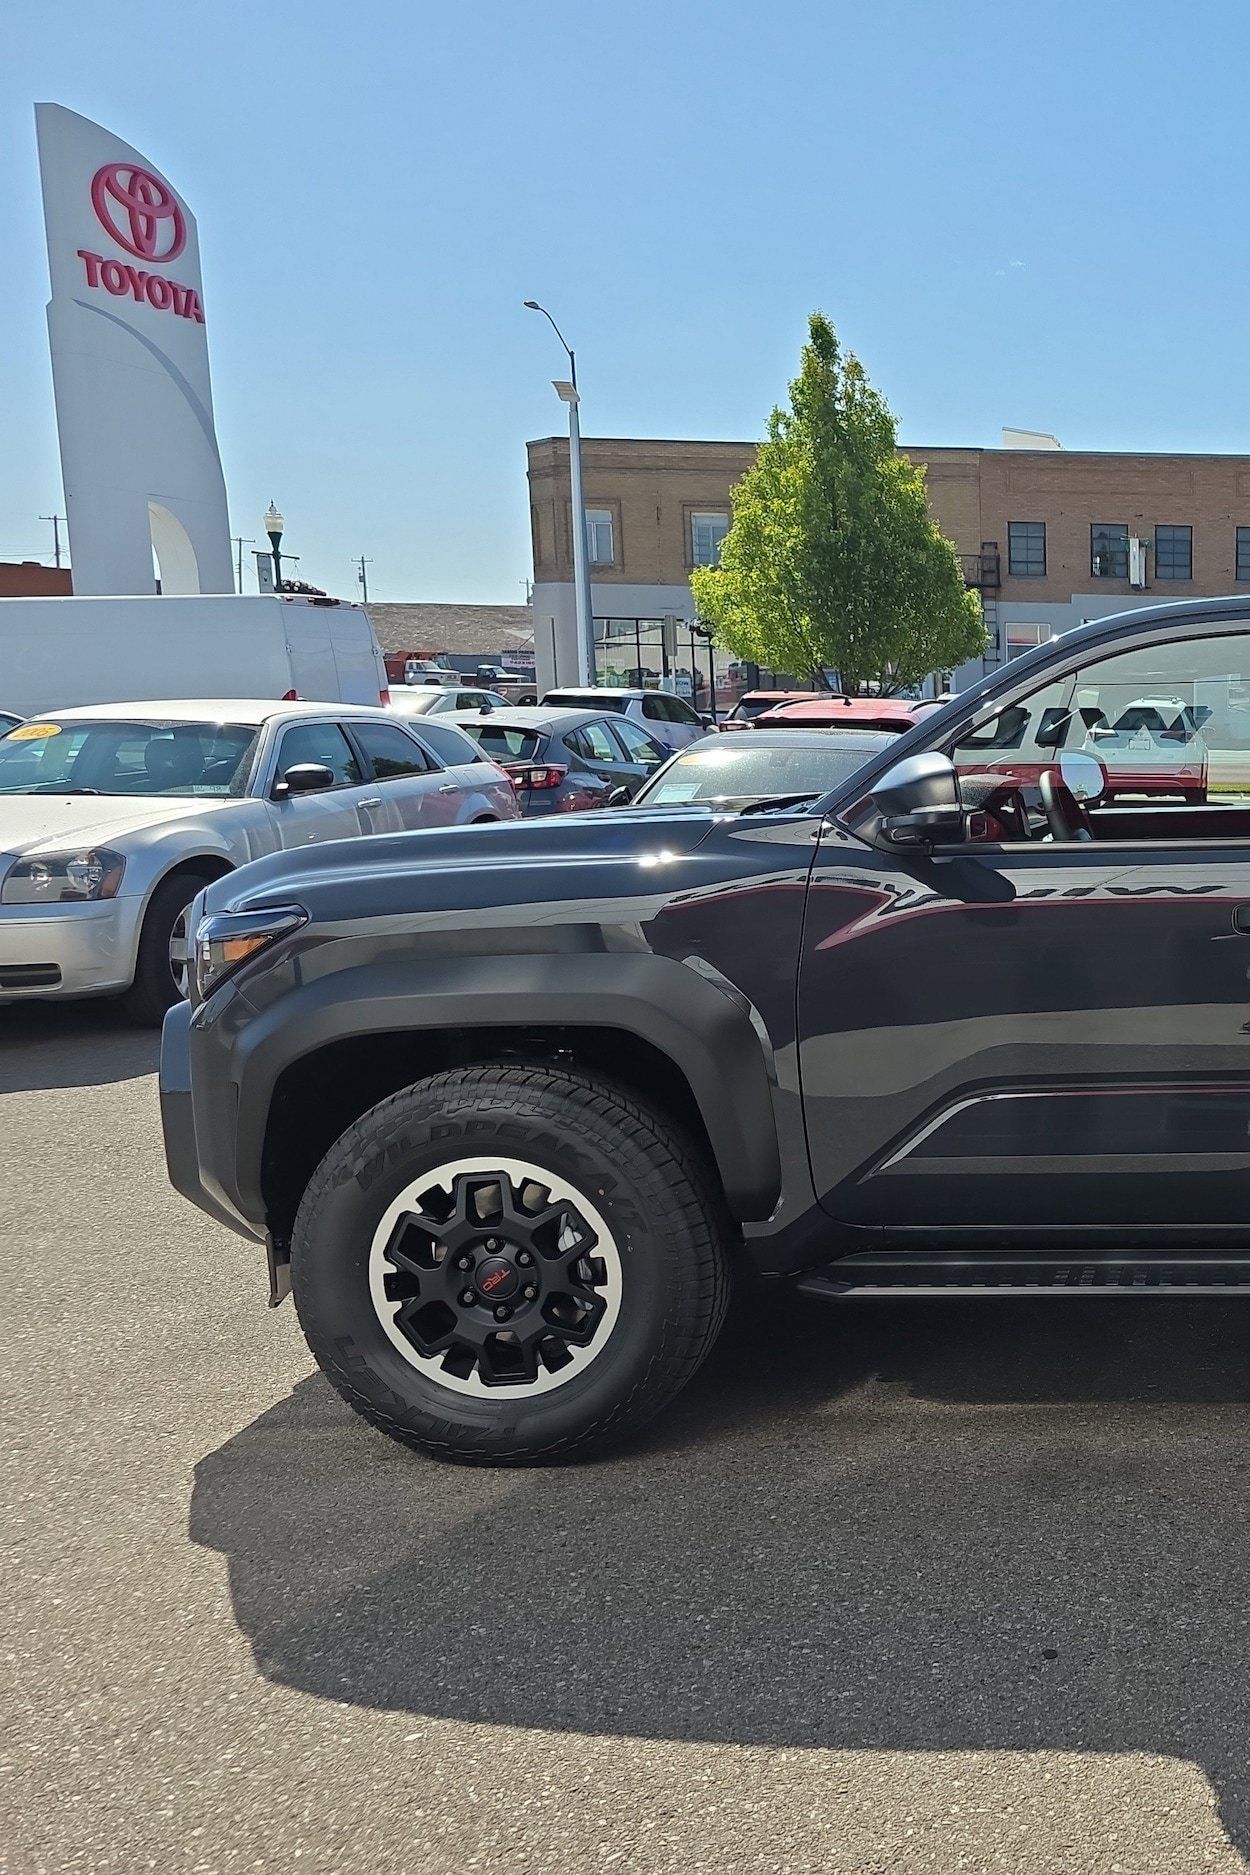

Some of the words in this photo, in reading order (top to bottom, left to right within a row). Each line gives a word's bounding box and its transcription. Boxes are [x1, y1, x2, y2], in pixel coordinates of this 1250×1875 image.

[78, 250, 205, 324] TOYOTA
[353, 1120, 596, 1191] WILDPEAK
[483, 1269, 510, 1291] TRD
